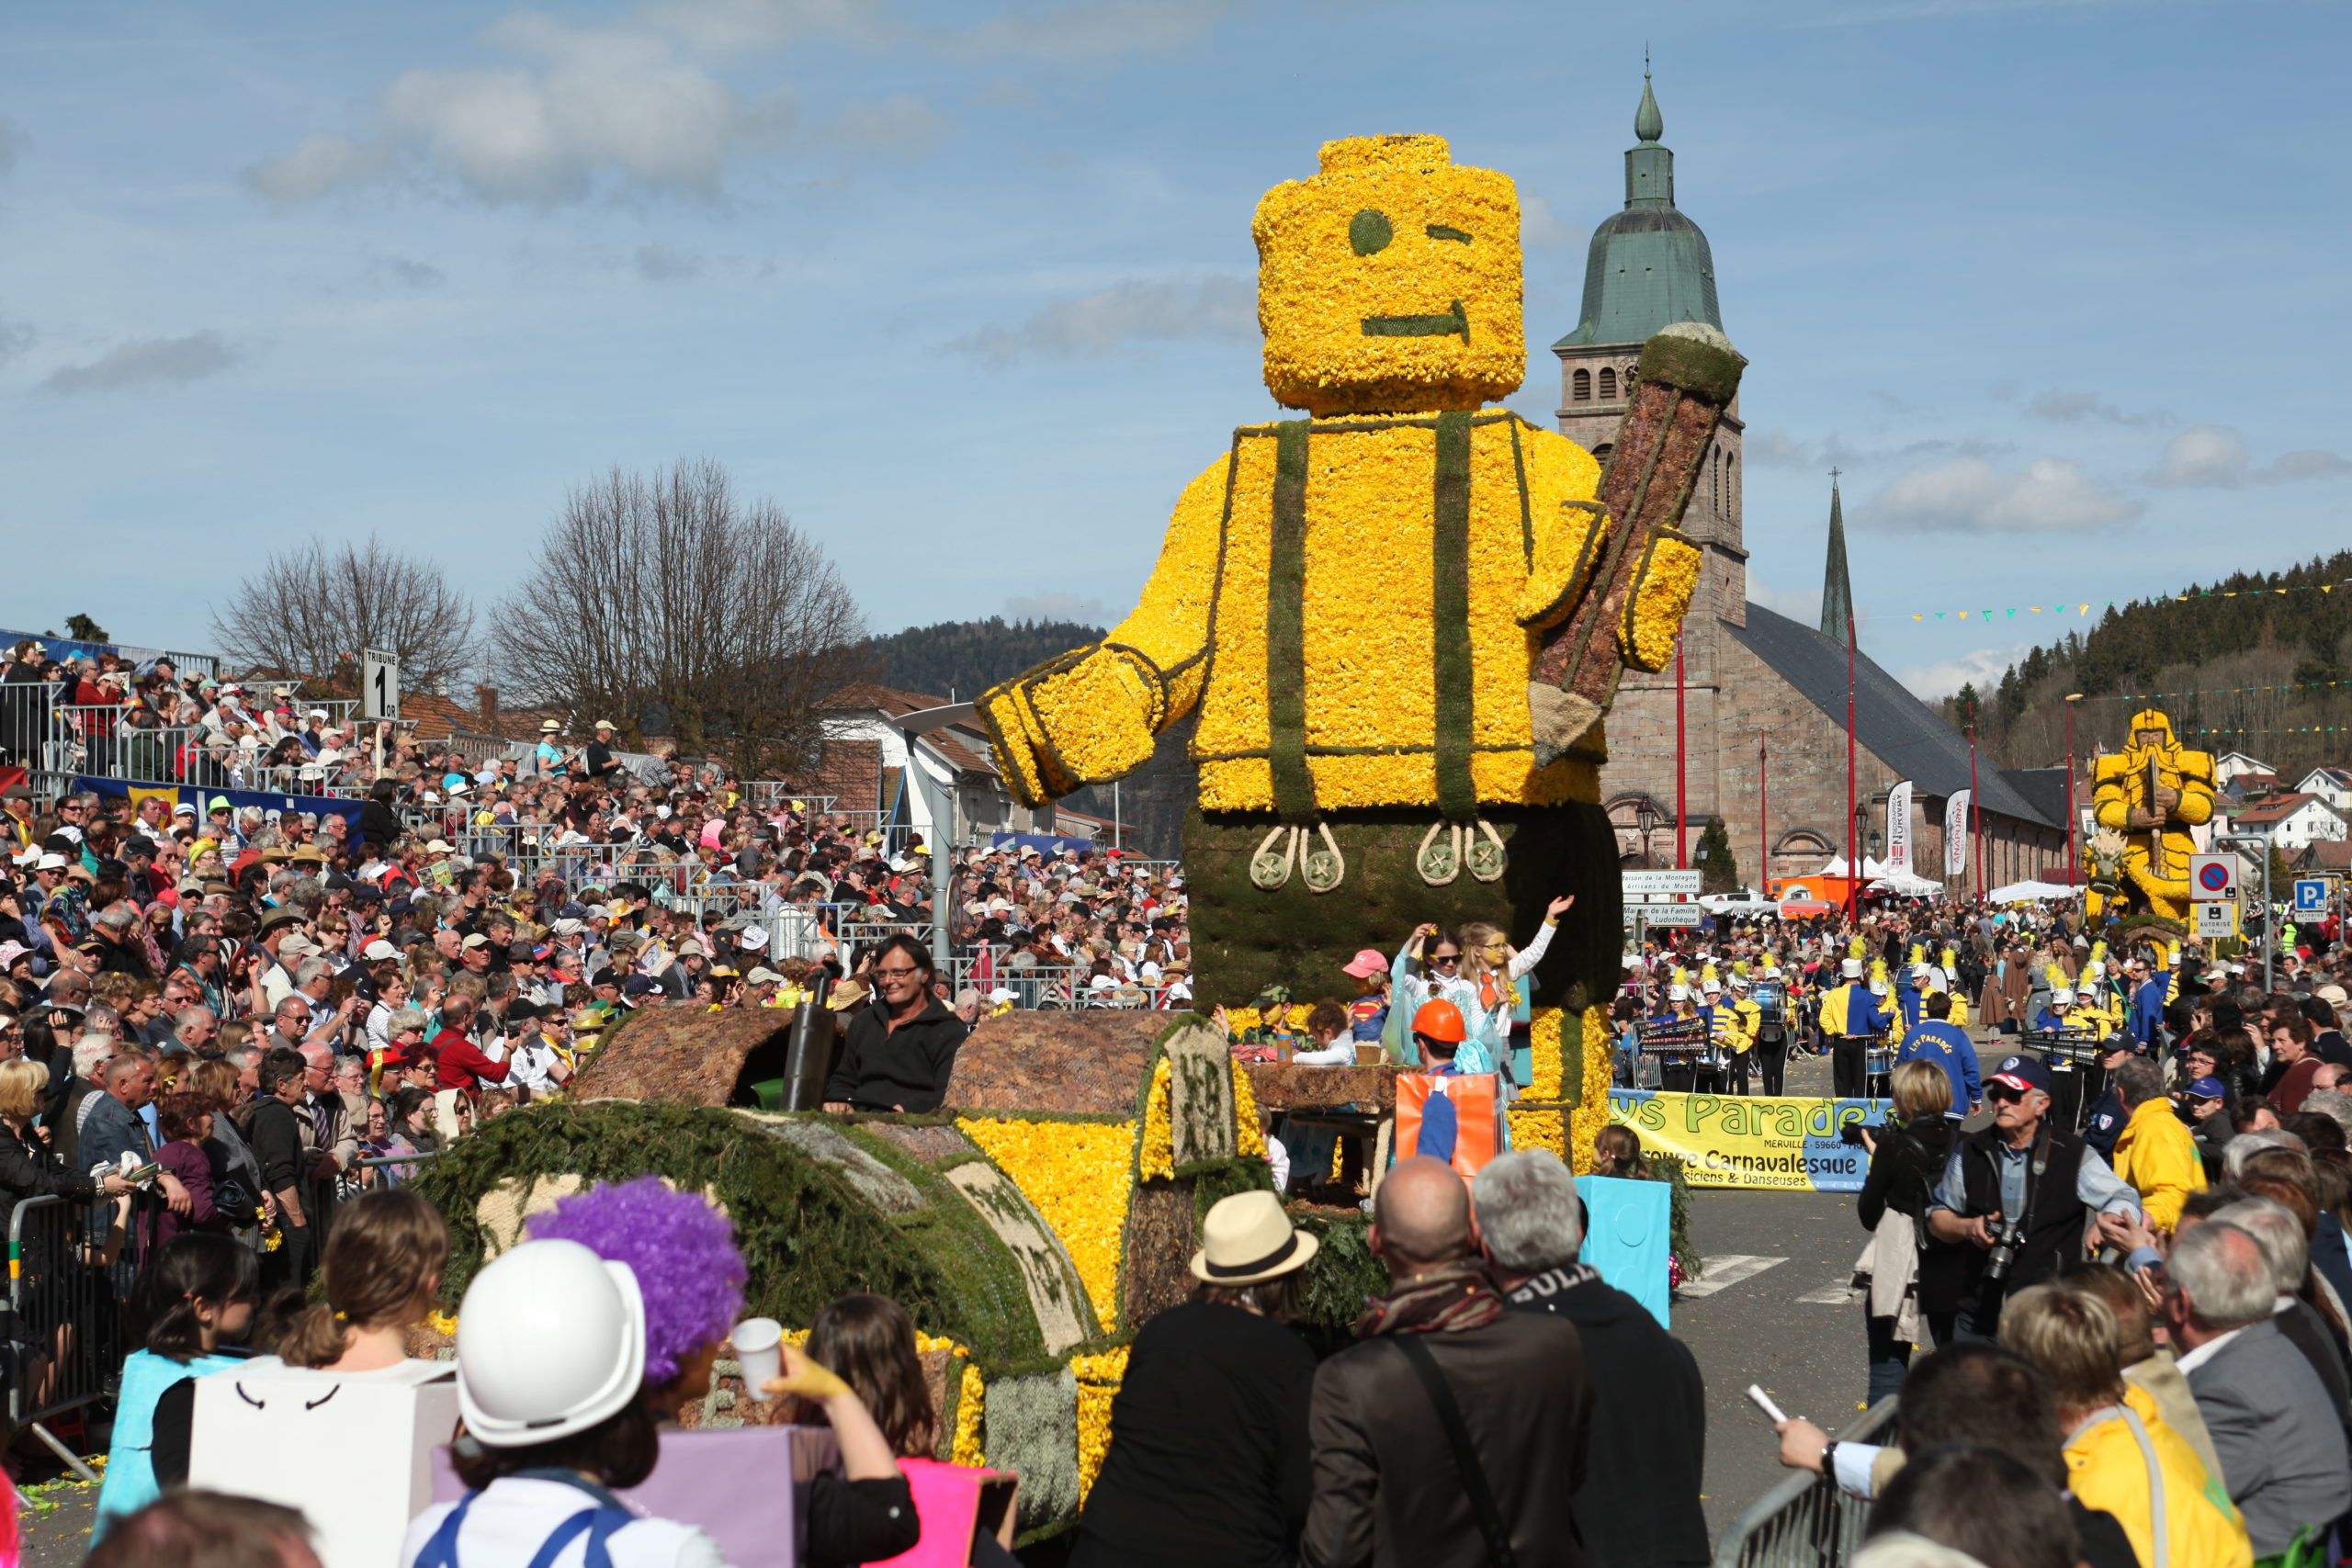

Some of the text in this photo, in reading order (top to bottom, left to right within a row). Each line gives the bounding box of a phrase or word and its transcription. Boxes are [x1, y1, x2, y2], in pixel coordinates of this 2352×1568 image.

[368, 651, 396, 666] TRIBUNE
[375, 665, 396, 718] 1 OR
[1893, 795, 1903, 845] NORWAY
[1953, 800, 1962, 863] ANAPURNA
[1764, 1139, 1808, 1149] MERVILLE
[1815, 1141, 1841, 1150] 59660
[1704, 1150, 1857, 1175] Carnavalesque
[1727, 1172, 1738, 1184] &
[1744, 1172, 1807, 1186] Danseuses
